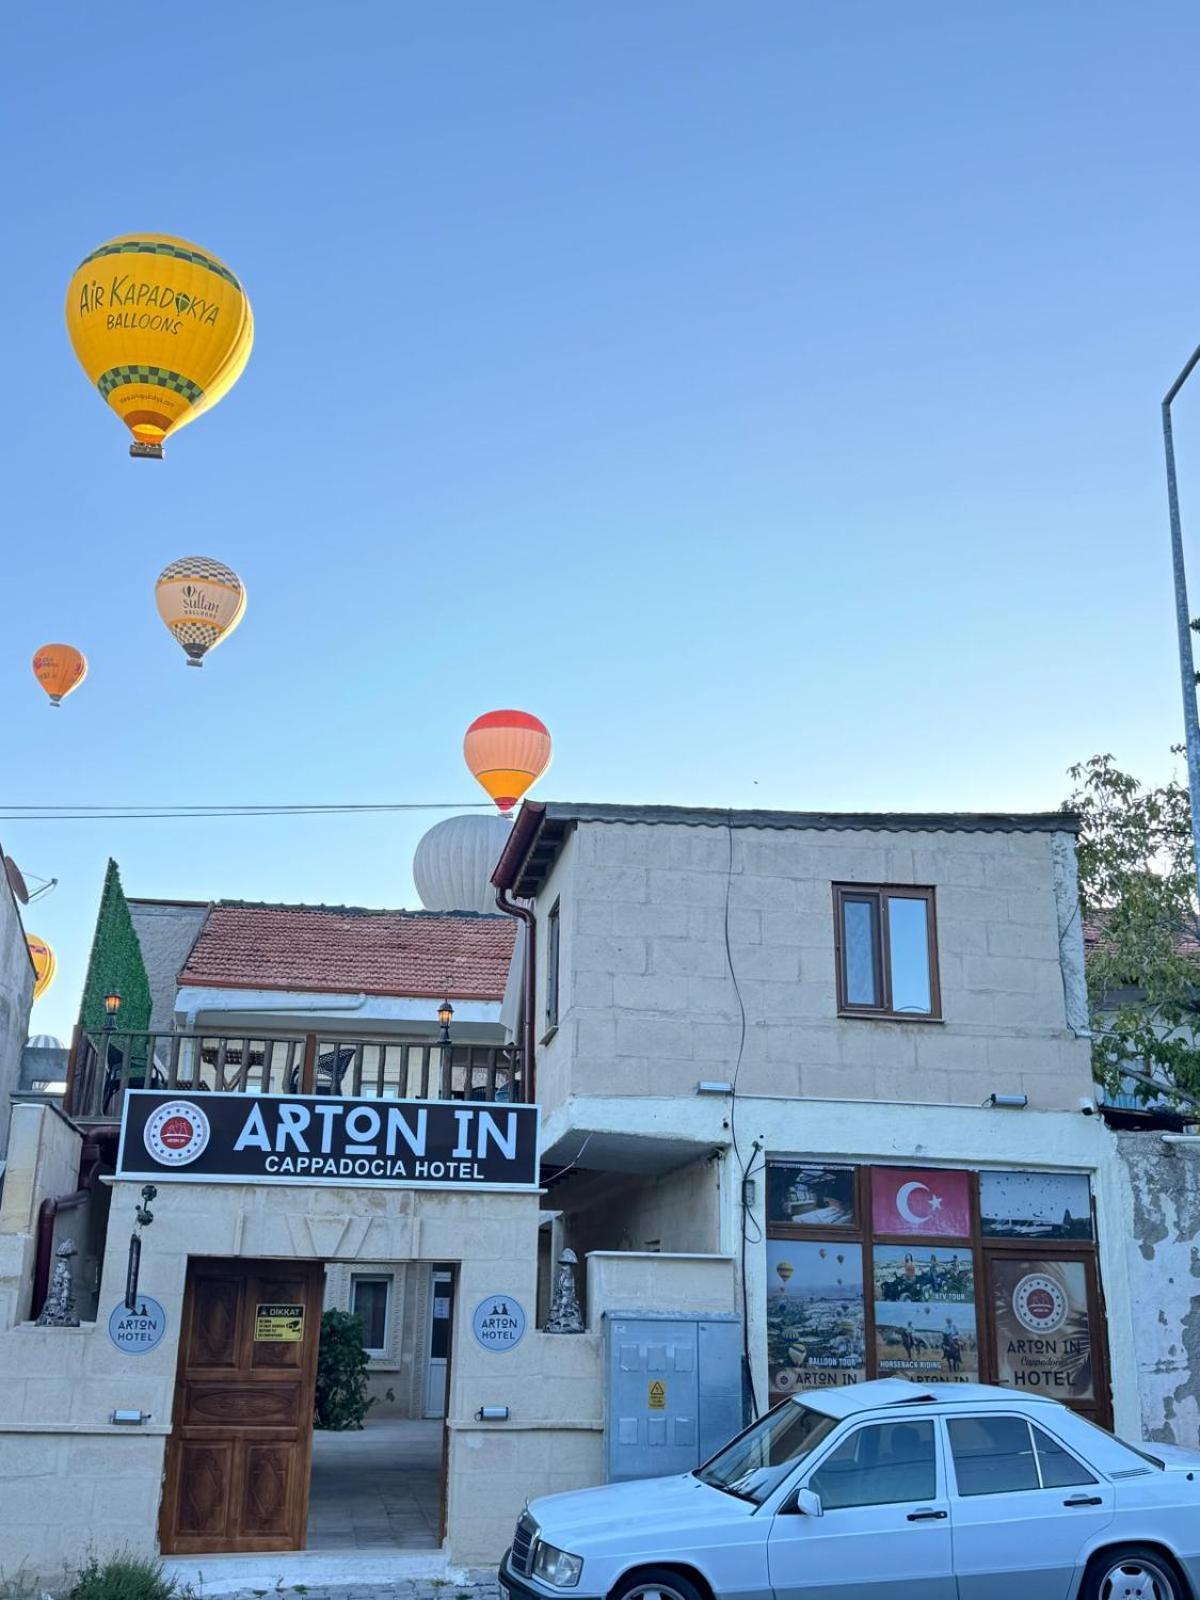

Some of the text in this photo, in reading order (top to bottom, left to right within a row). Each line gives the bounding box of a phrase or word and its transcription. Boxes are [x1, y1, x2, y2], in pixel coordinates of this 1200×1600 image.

[106, 312, 183, 335] BALLOONS
[232, 1101, 518, 1160] ARTON IN
[265, 1155, 485, 1179] CAPPADOCIA HOTEL
[117, 1319, 157, 1330] ARTON
[481, 1318, 517, 1329] ARTON
[117, 1332, 152, 1341] HOTEL
[481, 1331, 515, 1340] HOTEL
[1007, 1339, 1081, 1354] ARTON IN
[808, 1356, 856, 1366] BALLOON TOUR
[880, 1361, 918, 1369] HORSEBACK
[796, 1372, 858, 1386] ARTON IN
[1014, 1370, 1077, 1386] HOTEL
